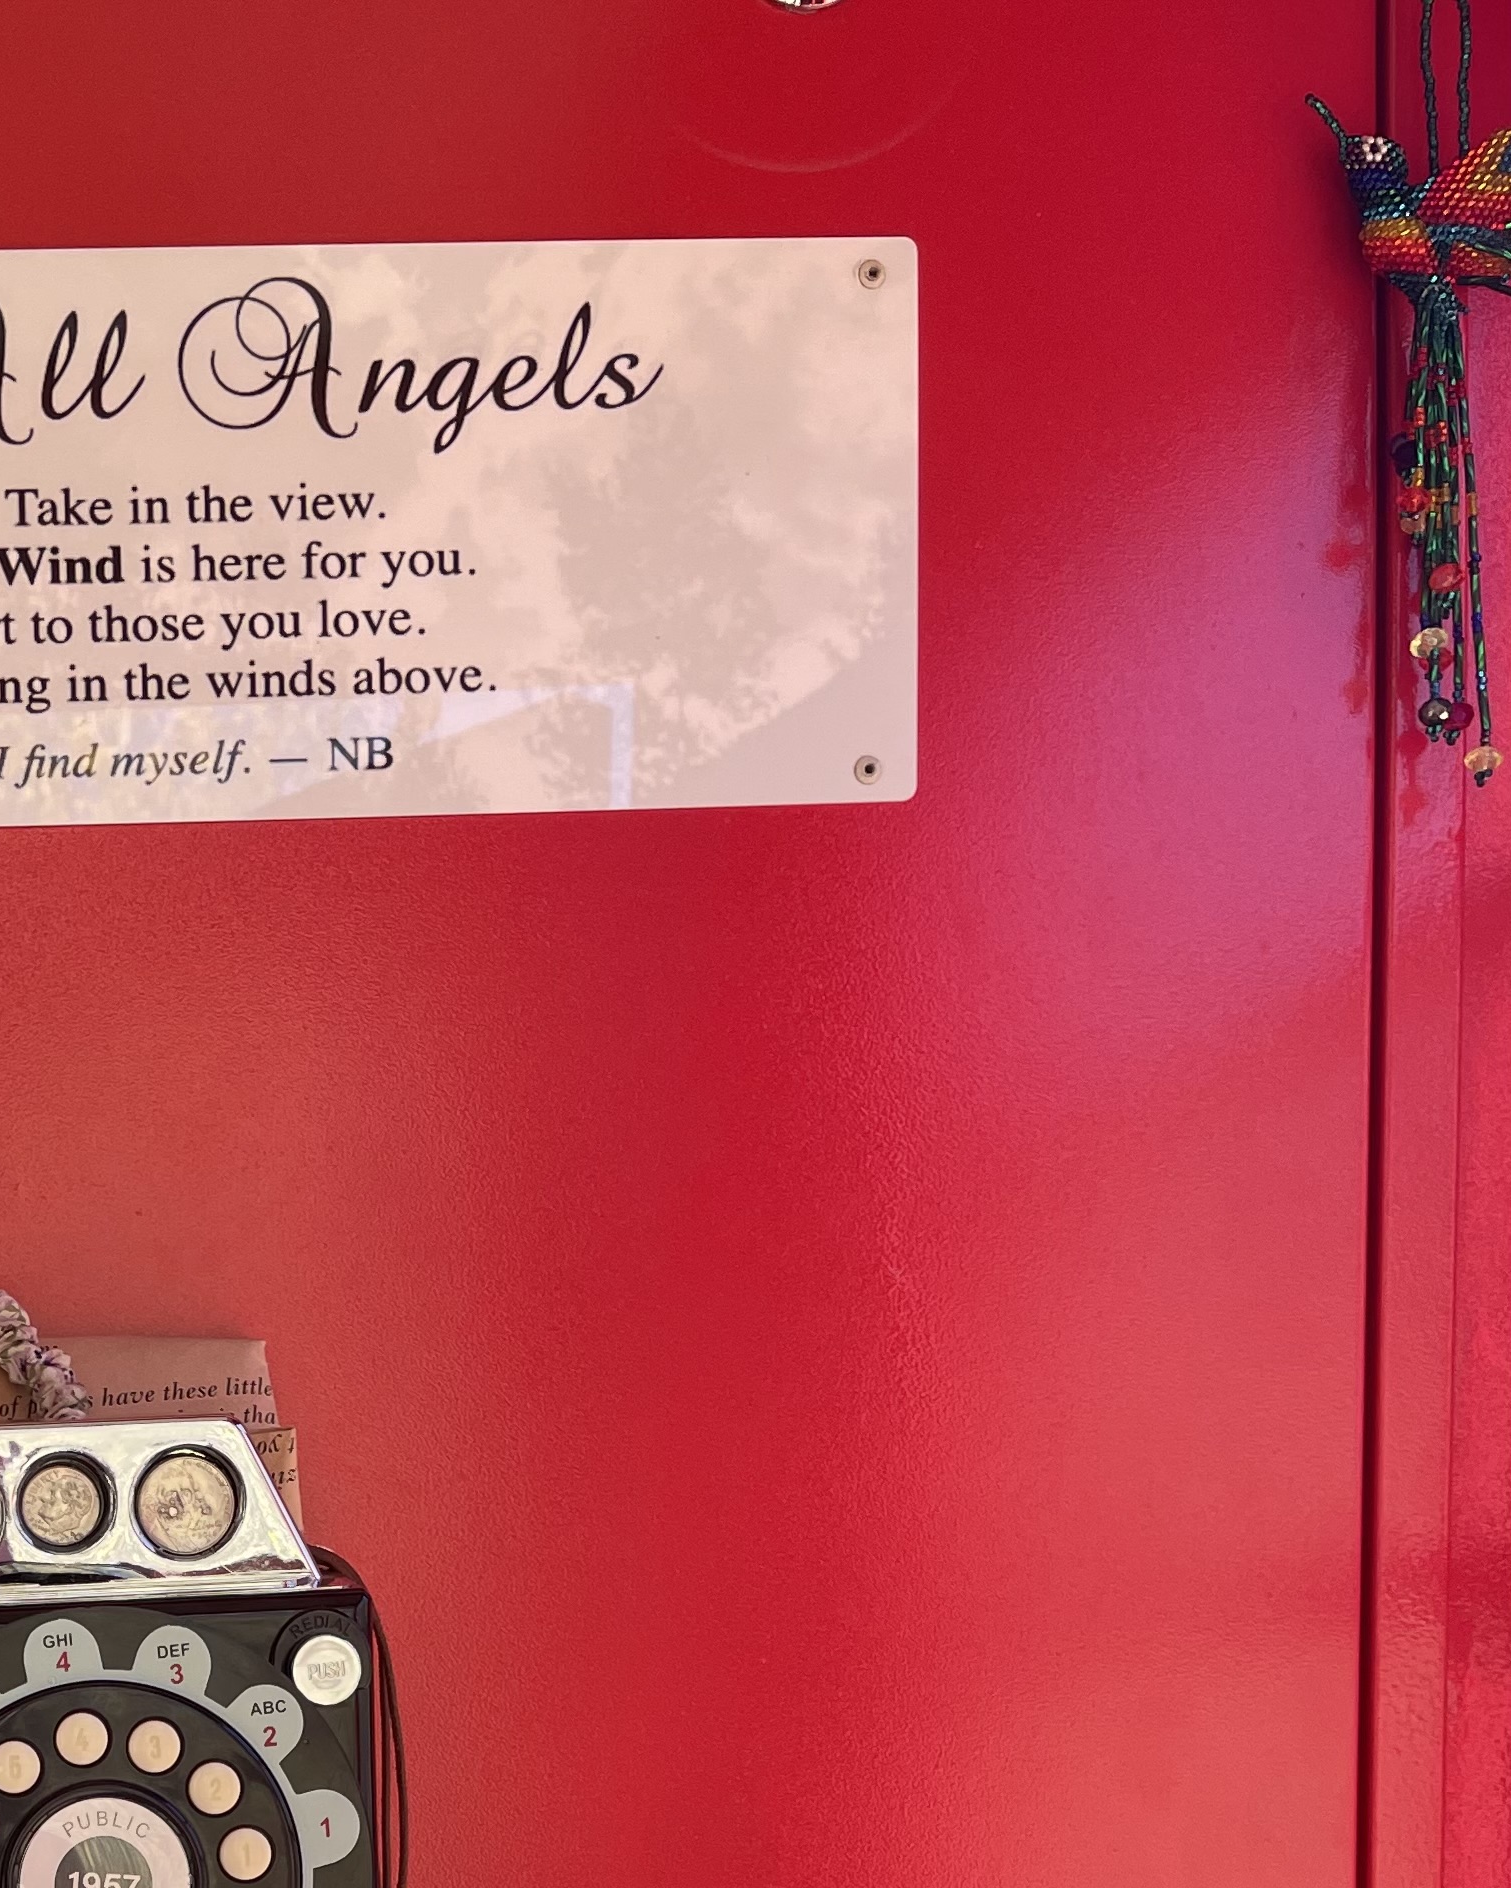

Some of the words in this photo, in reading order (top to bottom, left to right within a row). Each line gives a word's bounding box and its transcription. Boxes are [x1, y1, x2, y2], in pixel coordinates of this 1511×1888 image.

[177, 276, 665, 454] Angels
[4, 487, 113, 528] Take
[128, 485, 171, 525] in
[185, 484, 255, 524] the
[268, 482, 386, 522] view.
[140, 544, 176, 584] is
[191, 543, 287, 582] here
[300, 540, 367, 580] for
[379, 549, 476, 590] you.
[29, 610, 73, 646] to
[87, 603, 205, 643] those
[219, 611, 304, 652] you
[316, 598, 426, 638] love.
[66, 663, 110, 704] in
[122, 662, 191, 701] the
[205, 658, 337, 700] winds
[353, 656, 497, 696] above.
[13, 742, 99, 790] find
[110, 739, 250, 786] myself.
[326, 736, 394, 772] NB
[0, 1395, 23, 1421] of
[102, 1387, 155, 1407] have
[163, 1381, 218, 1401] these
[226, 1376, 273, 1397] little
[289, 1615, 351, 1639] REDIAL
[42, 1634, 74, 1649] GHI
[156, 1643, 190, 1659] DEF
[55, 1652, 72, 1672] 4
[307, 1660, 346, 1681] PUSH
[170, 1665, 184, 1685] 3
[250, 1700, 287, 1716] ABC
[263, 1727, 278, 1747] 2
[62, 1810, 151, 1839] PUBLIC
[320, 1818, 332, 1838] 1
